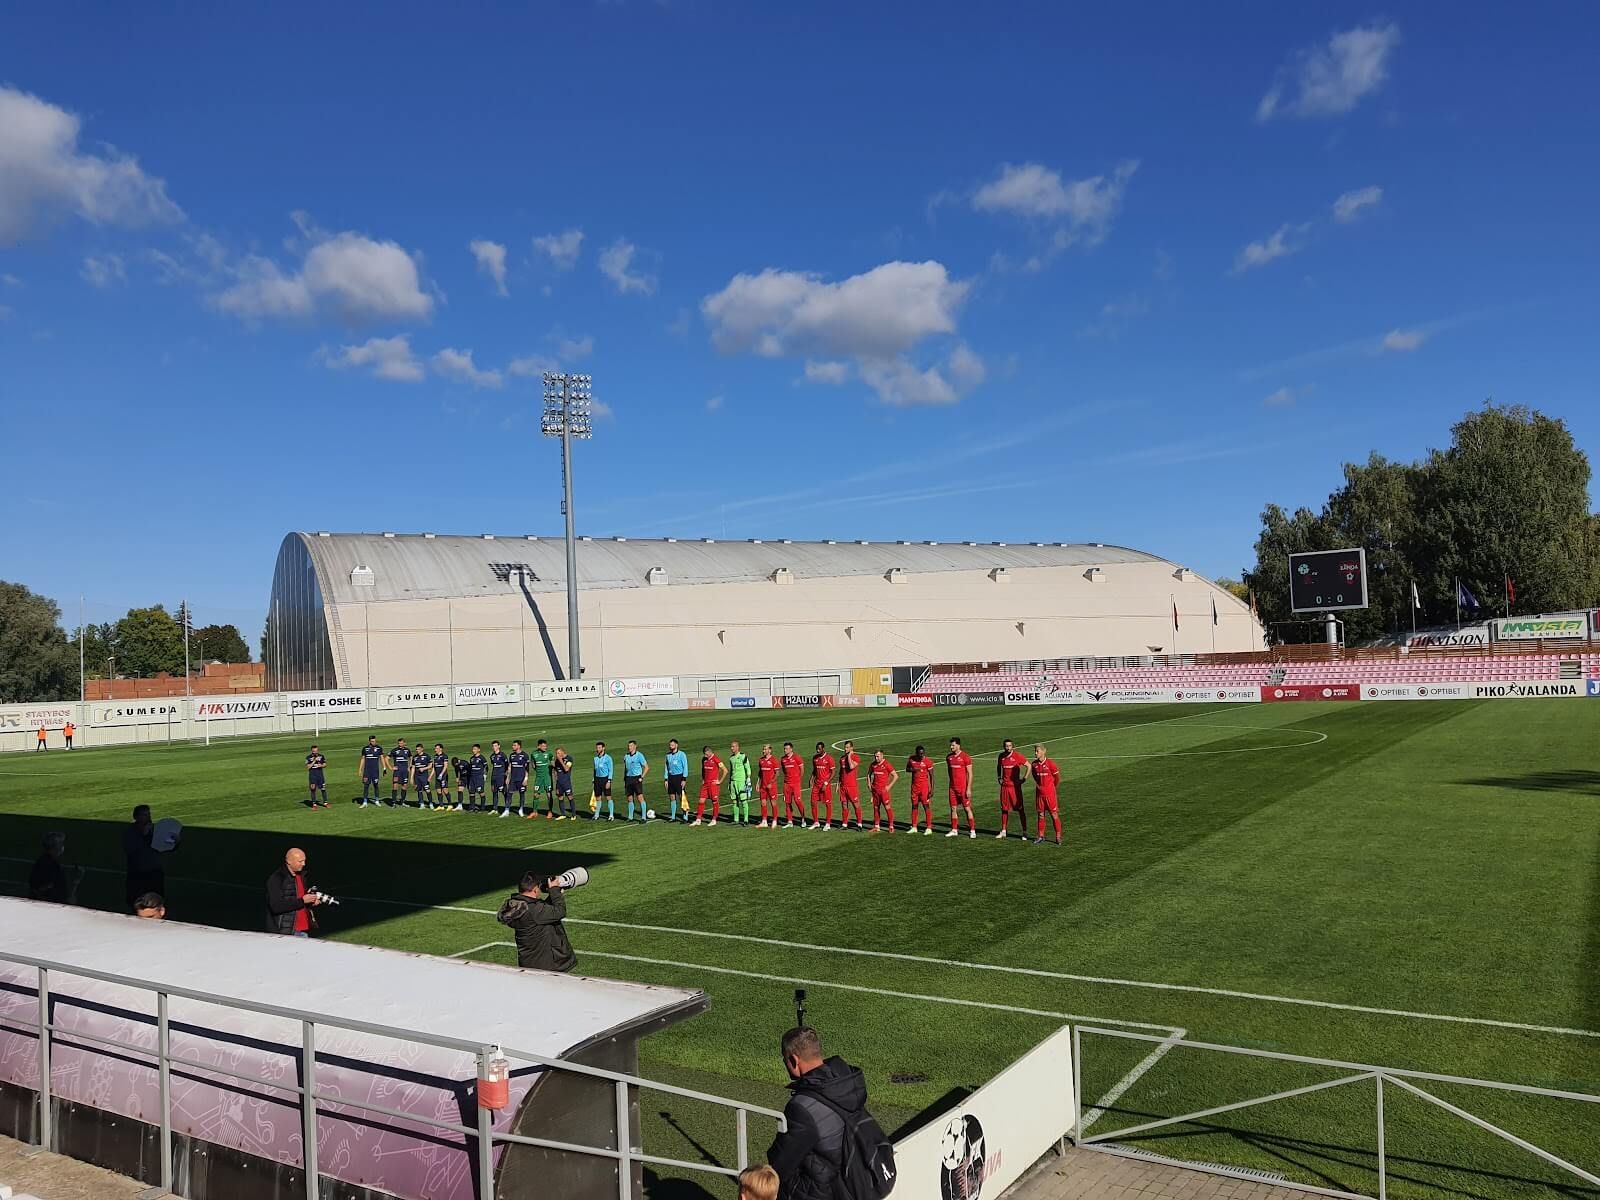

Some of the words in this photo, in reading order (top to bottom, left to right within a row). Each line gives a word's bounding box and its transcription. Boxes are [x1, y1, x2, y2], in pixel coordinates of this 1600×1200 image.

[459, 687, 498, 698] AQUAVIA
[1381, 688, 1410, 696] OPTIBET
[1430, 687, 1461, 696] OPTIBET
[1476, 687, 1505, 697] PIKO
[1518, 684, 1577, 696] VALANDA
[397, 693, 444, 701] SUMEDA
[785, 695, 819, 704] H2AUTO
[1007, 692, 1041, 701] OSHEE
[328, 697, 362, 706] OSHEE
[117, 706, 177, 716] SUMEDA
[198, 702, 271, 715] HIKVISION
